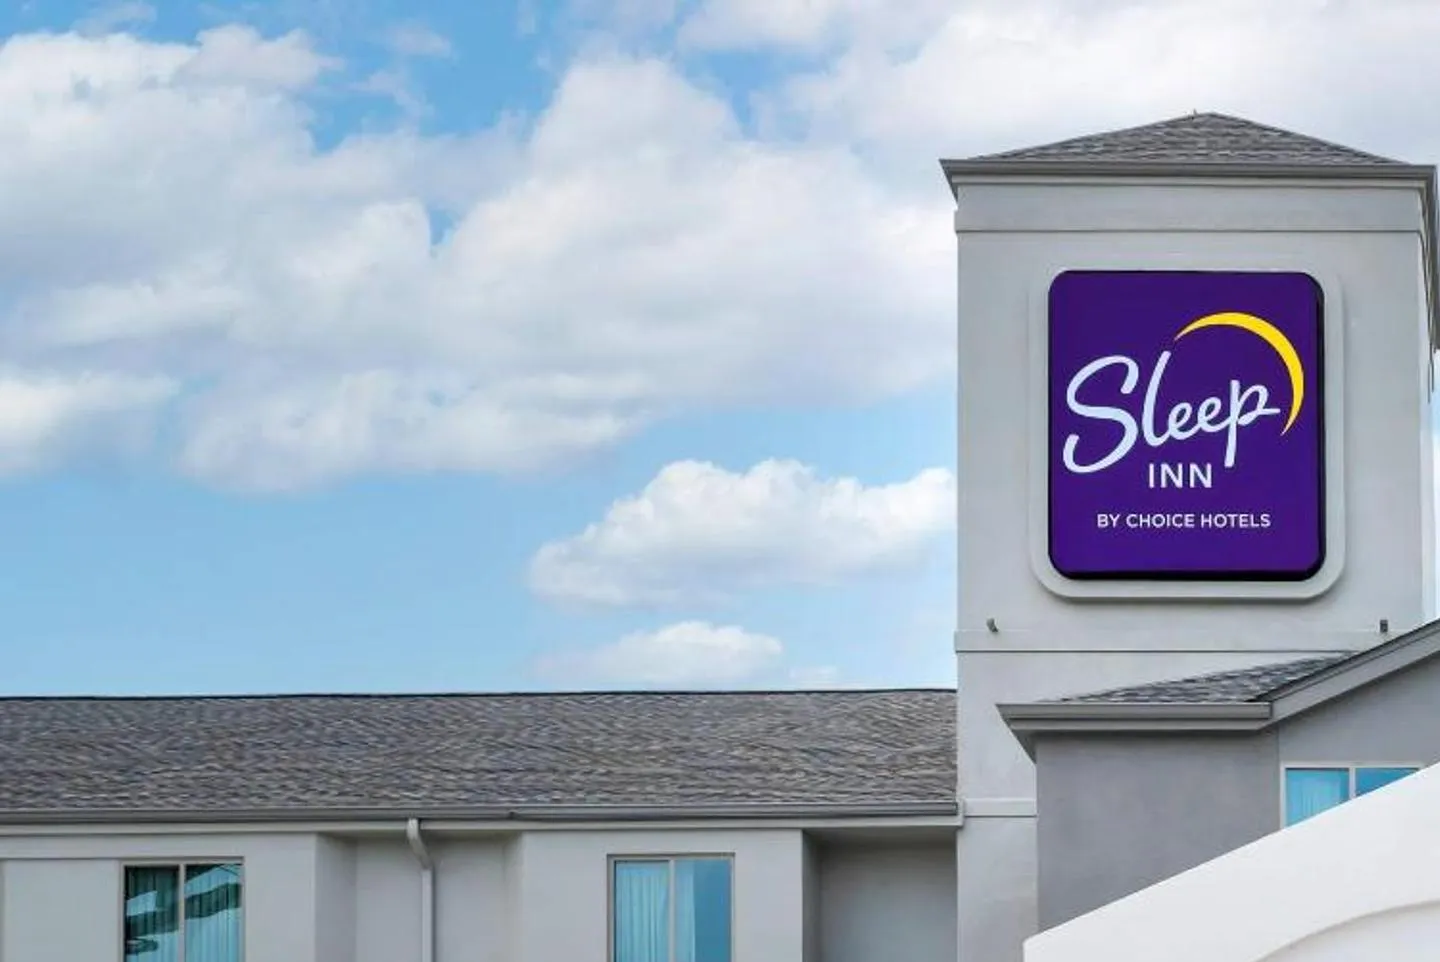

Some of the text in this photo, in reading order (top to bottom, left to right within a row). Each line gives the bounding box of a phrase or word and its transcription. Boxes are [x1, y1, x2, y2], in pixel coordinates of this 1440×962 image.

[1063, 351, 1280, 473] Sleep
[1148, 463, 1212, 489] INN
[1097, 513, 1271, 528] BY CHOICE HOTELS
